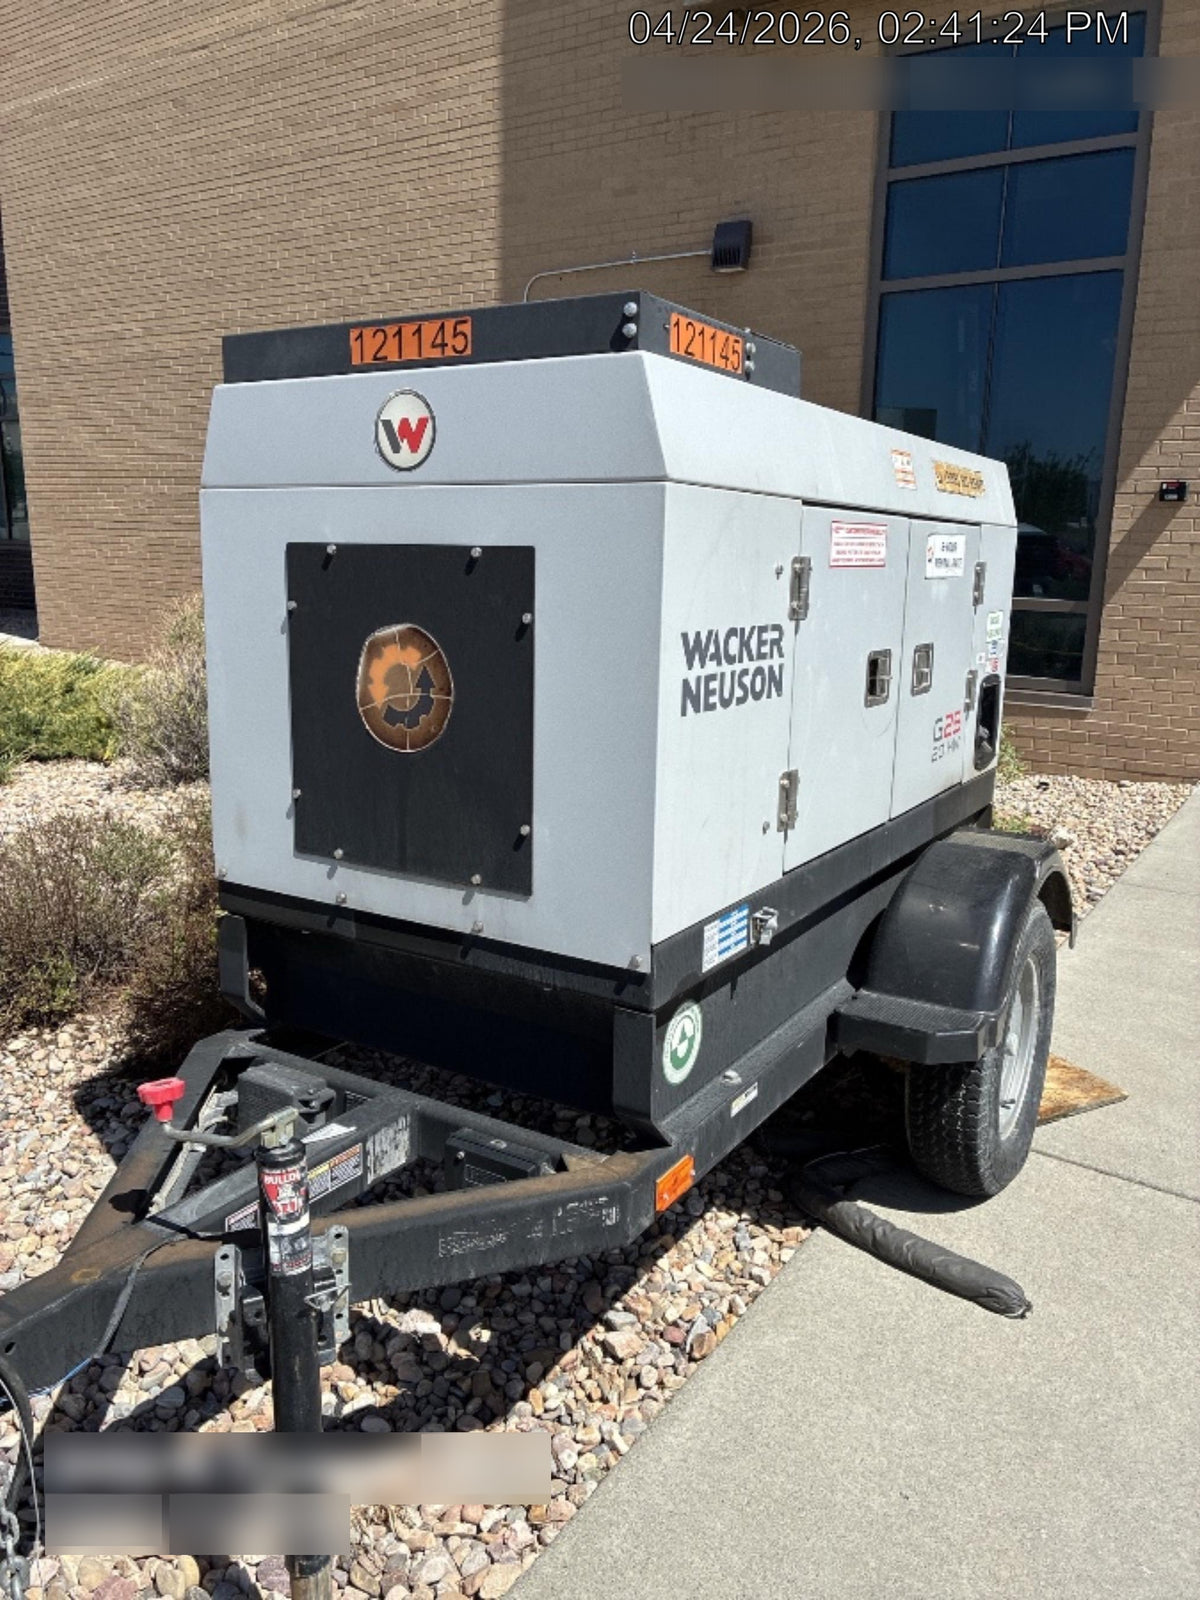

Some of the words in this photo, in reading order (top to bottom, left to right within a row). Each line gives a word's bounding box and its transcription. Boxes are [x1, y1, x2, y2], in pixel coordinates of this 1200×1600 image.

[354, 319, 469, 363] 121145
[673, 317, 741, 371] 121145
[680, 623, 785, 671] WACKER
[680, 663, 785, 717] NEUSON
[932, 710, 962, 742] G25
